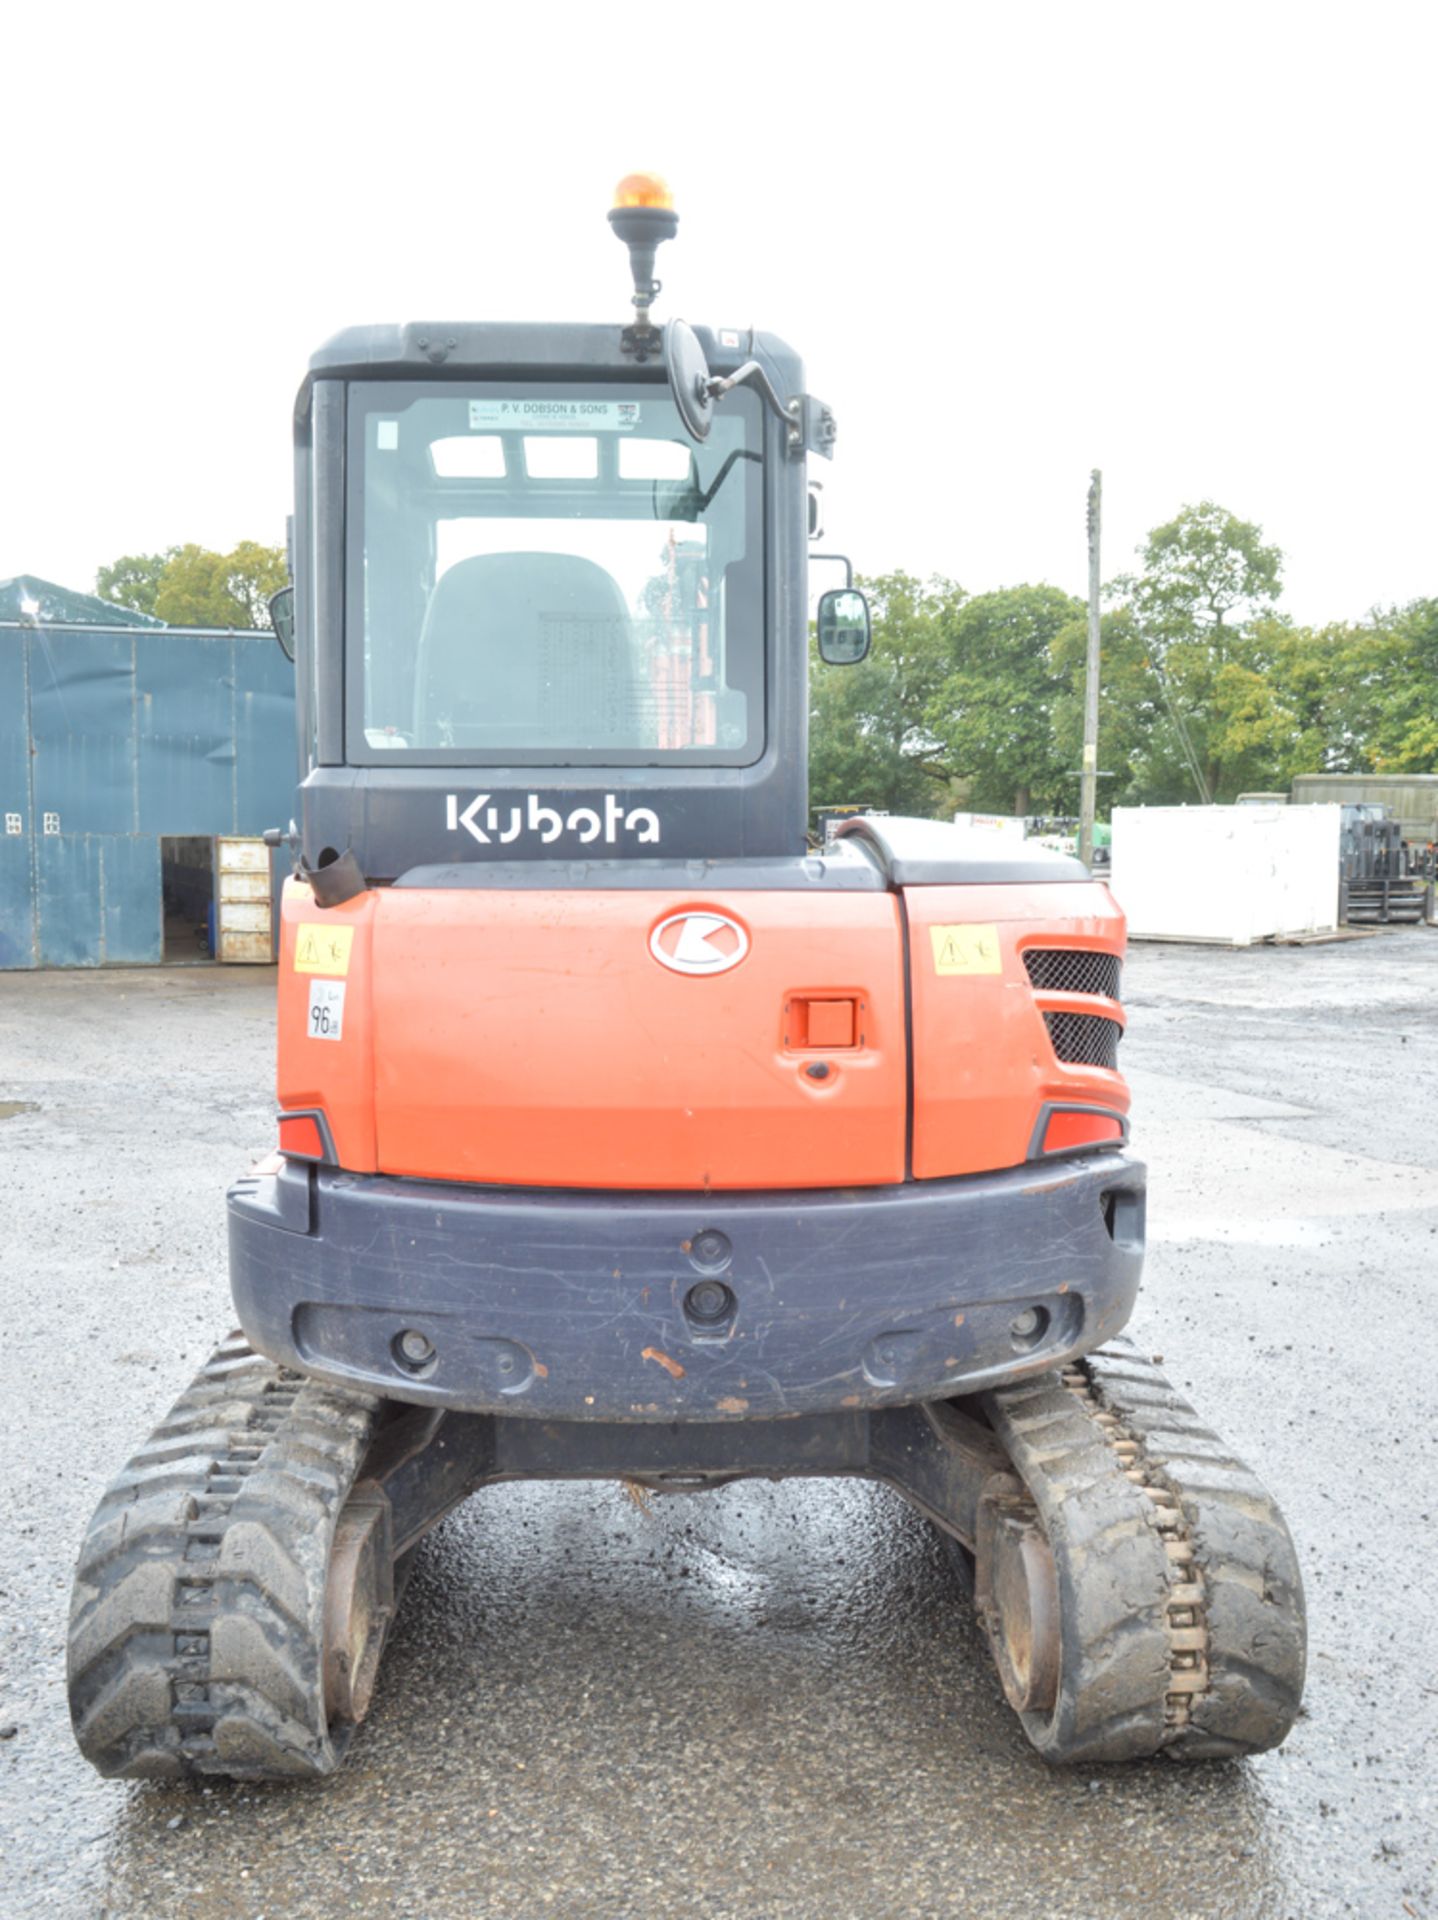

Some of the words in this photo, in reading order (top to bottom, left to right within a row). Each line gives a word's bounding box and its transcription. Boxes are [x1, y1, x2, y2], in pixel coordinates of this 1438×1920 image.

[501, 402, 511, 414] P.
[523, 403, 568, 414] DOBSON
[569, 404, 577, 414] &
[580, 404, 608, 415] SONS
[446, 794, 660, 844] Kubota
[311, 1005, 331, 1034] 96
